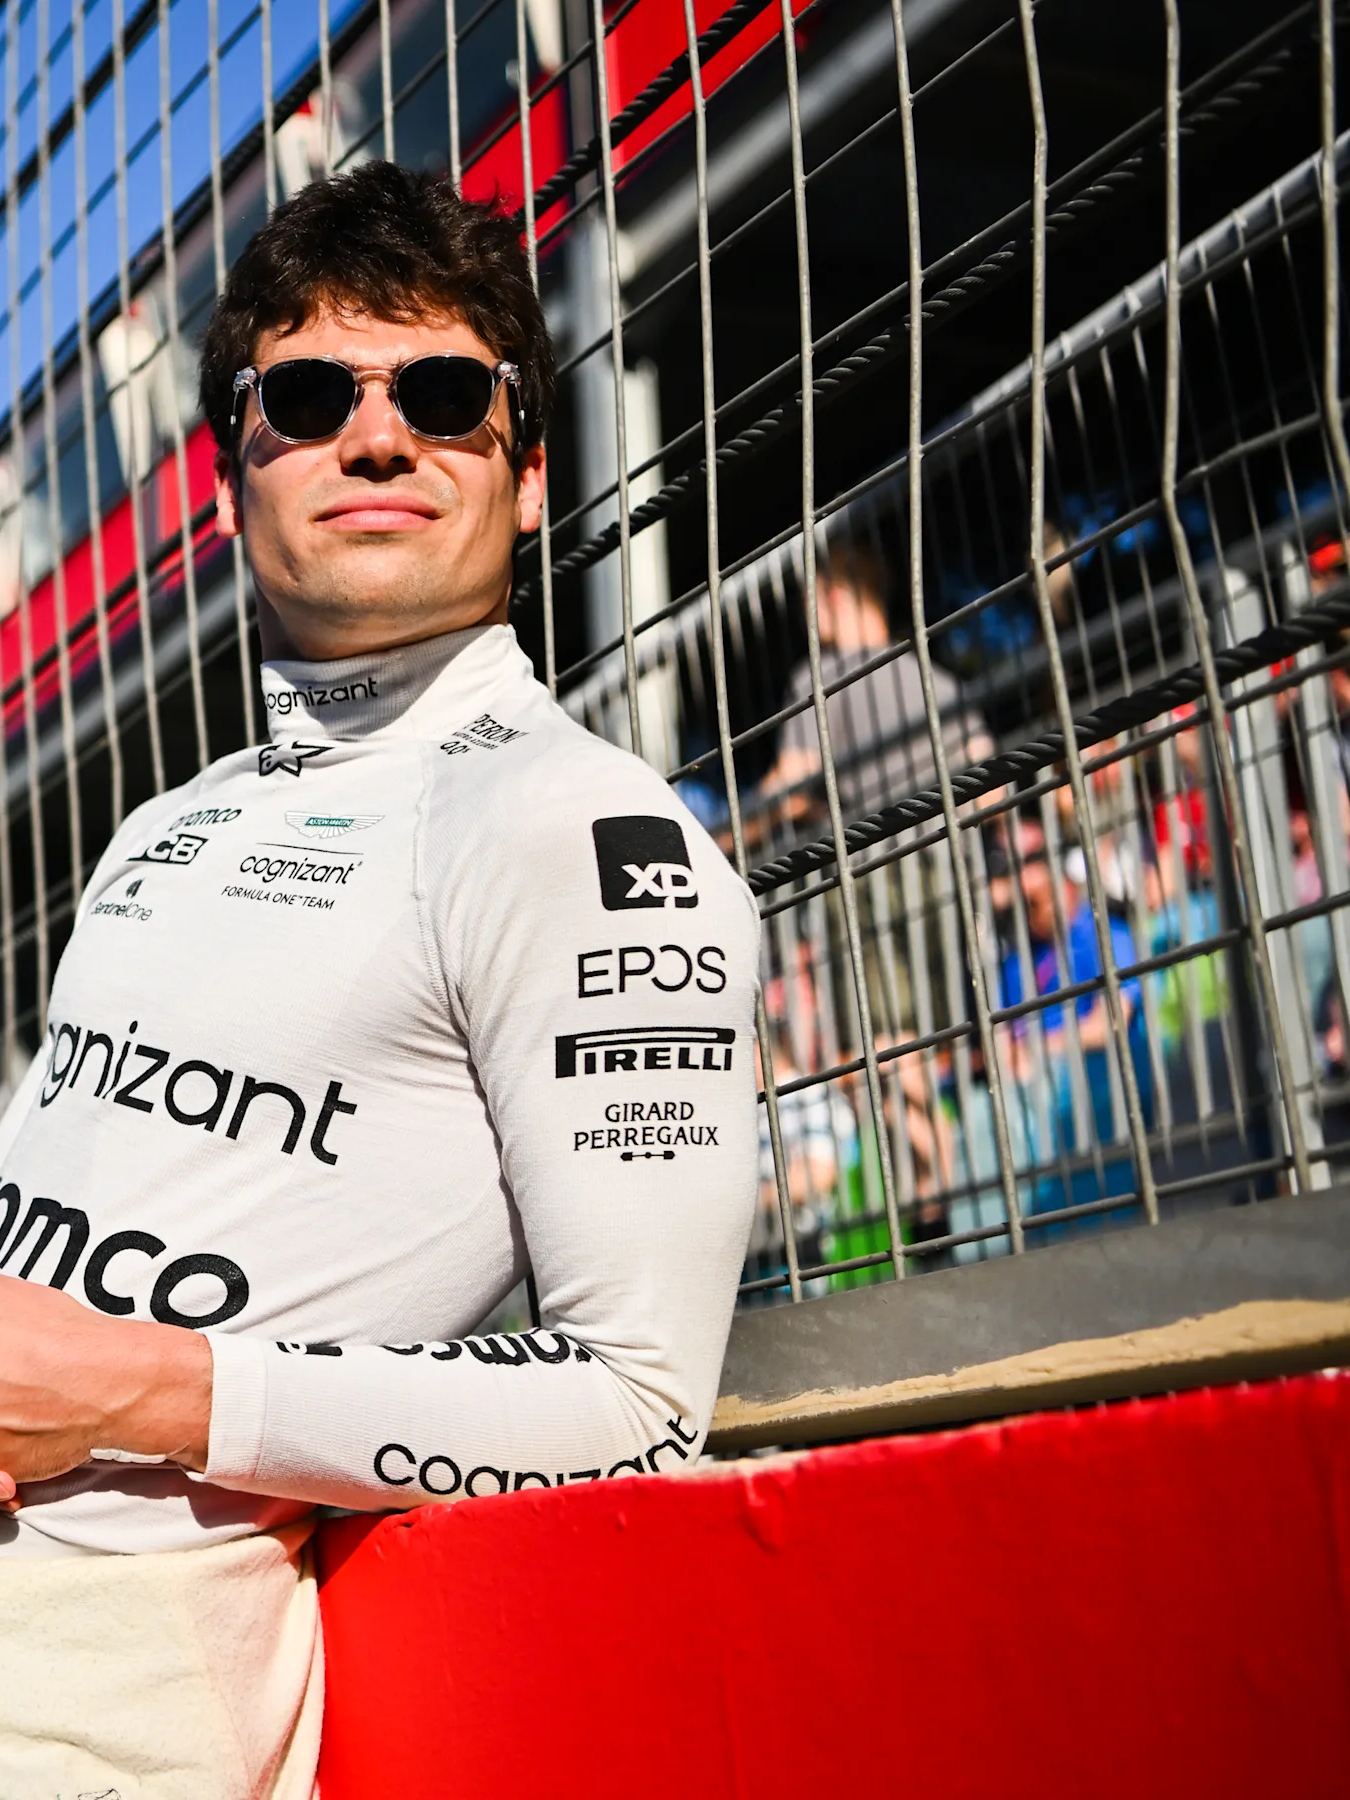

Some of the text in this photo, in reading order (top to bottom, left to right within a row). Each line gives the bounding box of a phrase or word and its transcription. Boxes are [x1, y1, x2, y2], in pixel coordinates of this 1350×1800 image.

[265, 677, 379, 715] ognizant
[128, 833, 208, 864] CB
[220, 885, 270, 901] FORMULA
[301, 896, 336, 910] TEAM
[577, 944, 727, 999] EPOS
[555, 1026, 736, 1079] PIRELLI
[40, 1020, 358, 1166] gnizant
[604, 1101, 695, 1123] GIRARD
[573, 1126, 720, 1151] PERREGAUX
